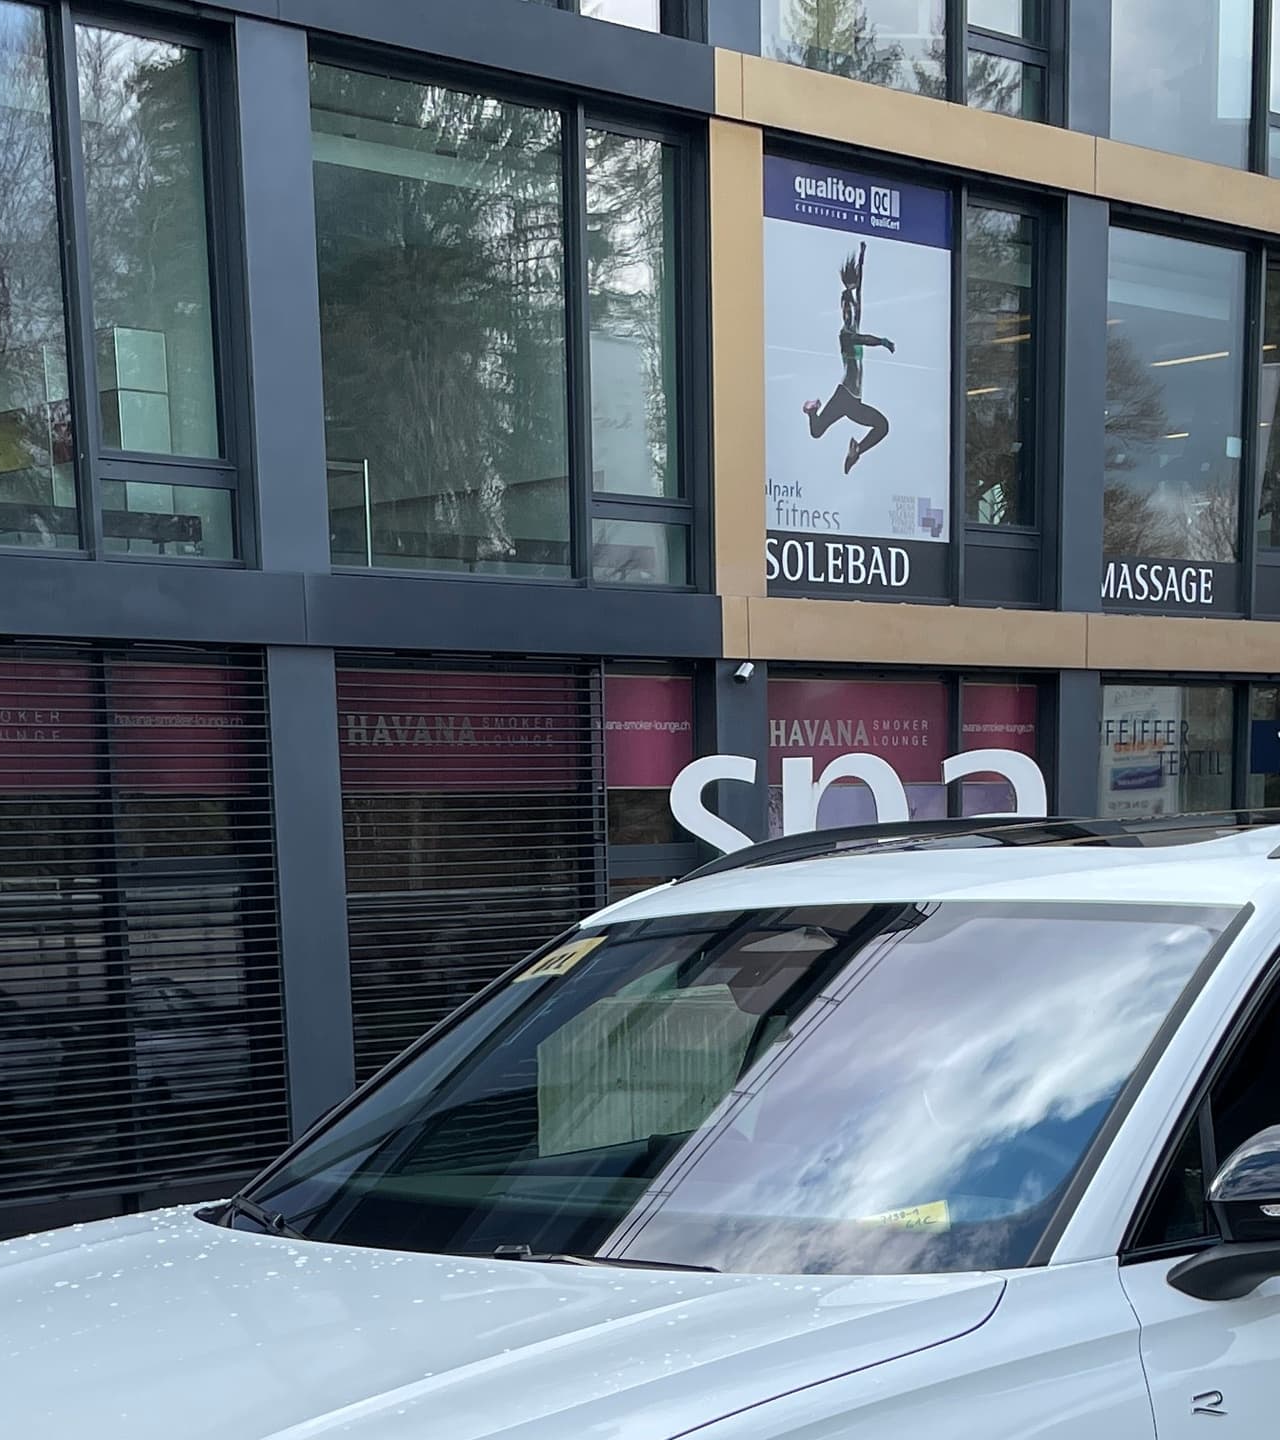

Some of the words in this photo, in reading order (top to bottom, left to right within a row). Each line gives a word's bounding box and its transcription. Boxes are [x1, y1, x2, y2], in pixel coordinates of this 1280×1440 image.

[795, 175, 866, 209] qualitop
[765, 479, 803, 502] lpark
[775, 499, 841, 530] fitness
[767, 538, 910, 587] SOLEBAD
[1101, 562, 1213, 604] MASSAGE
[346, 714, 478, 746] HAVANA
[482, 716, 554, 730] SMOKER
[483, 733, 554, 746] LOUNGE
[769, 719, 871, 748] HAVANA
[873, 719, 929, 731] SMOKER
[873, 735, 929, 747] LOUNGE
[1098, 720, 1190, 747] FEIFFER
[1156, 750, 1223, 776] TEXTIL
